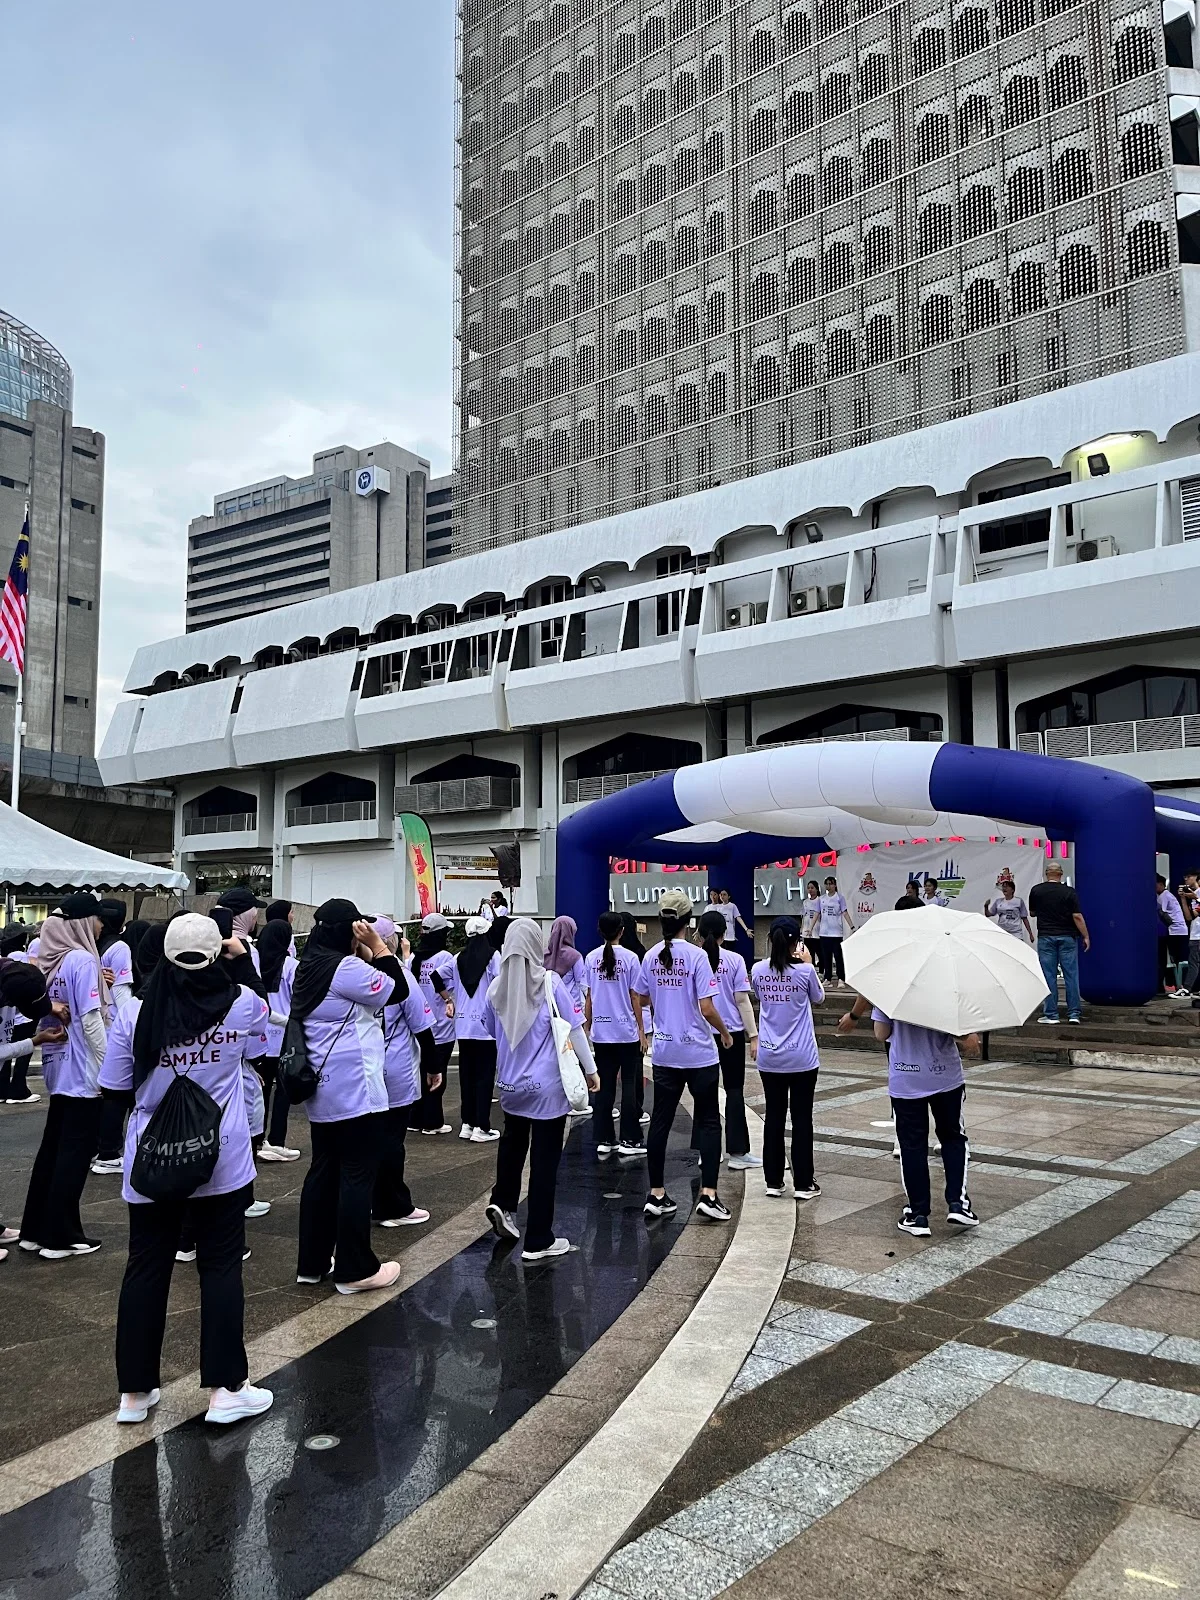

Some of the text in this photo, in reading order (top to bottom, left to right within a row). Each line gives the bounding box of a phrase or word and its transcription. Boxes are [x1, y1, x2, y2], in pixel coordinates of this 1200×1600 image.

[623, 882, 709, 903] Lumur
[654, 958, 685, 967] POER
[650, 968, 690, 978] THROUGH
[657, 978, 683, 987] SMILE
[759, 975, 792, 983] POWER
[763, 994, 791, 1002] SMILE
[160, 1049, 221, 1067] SMILE
